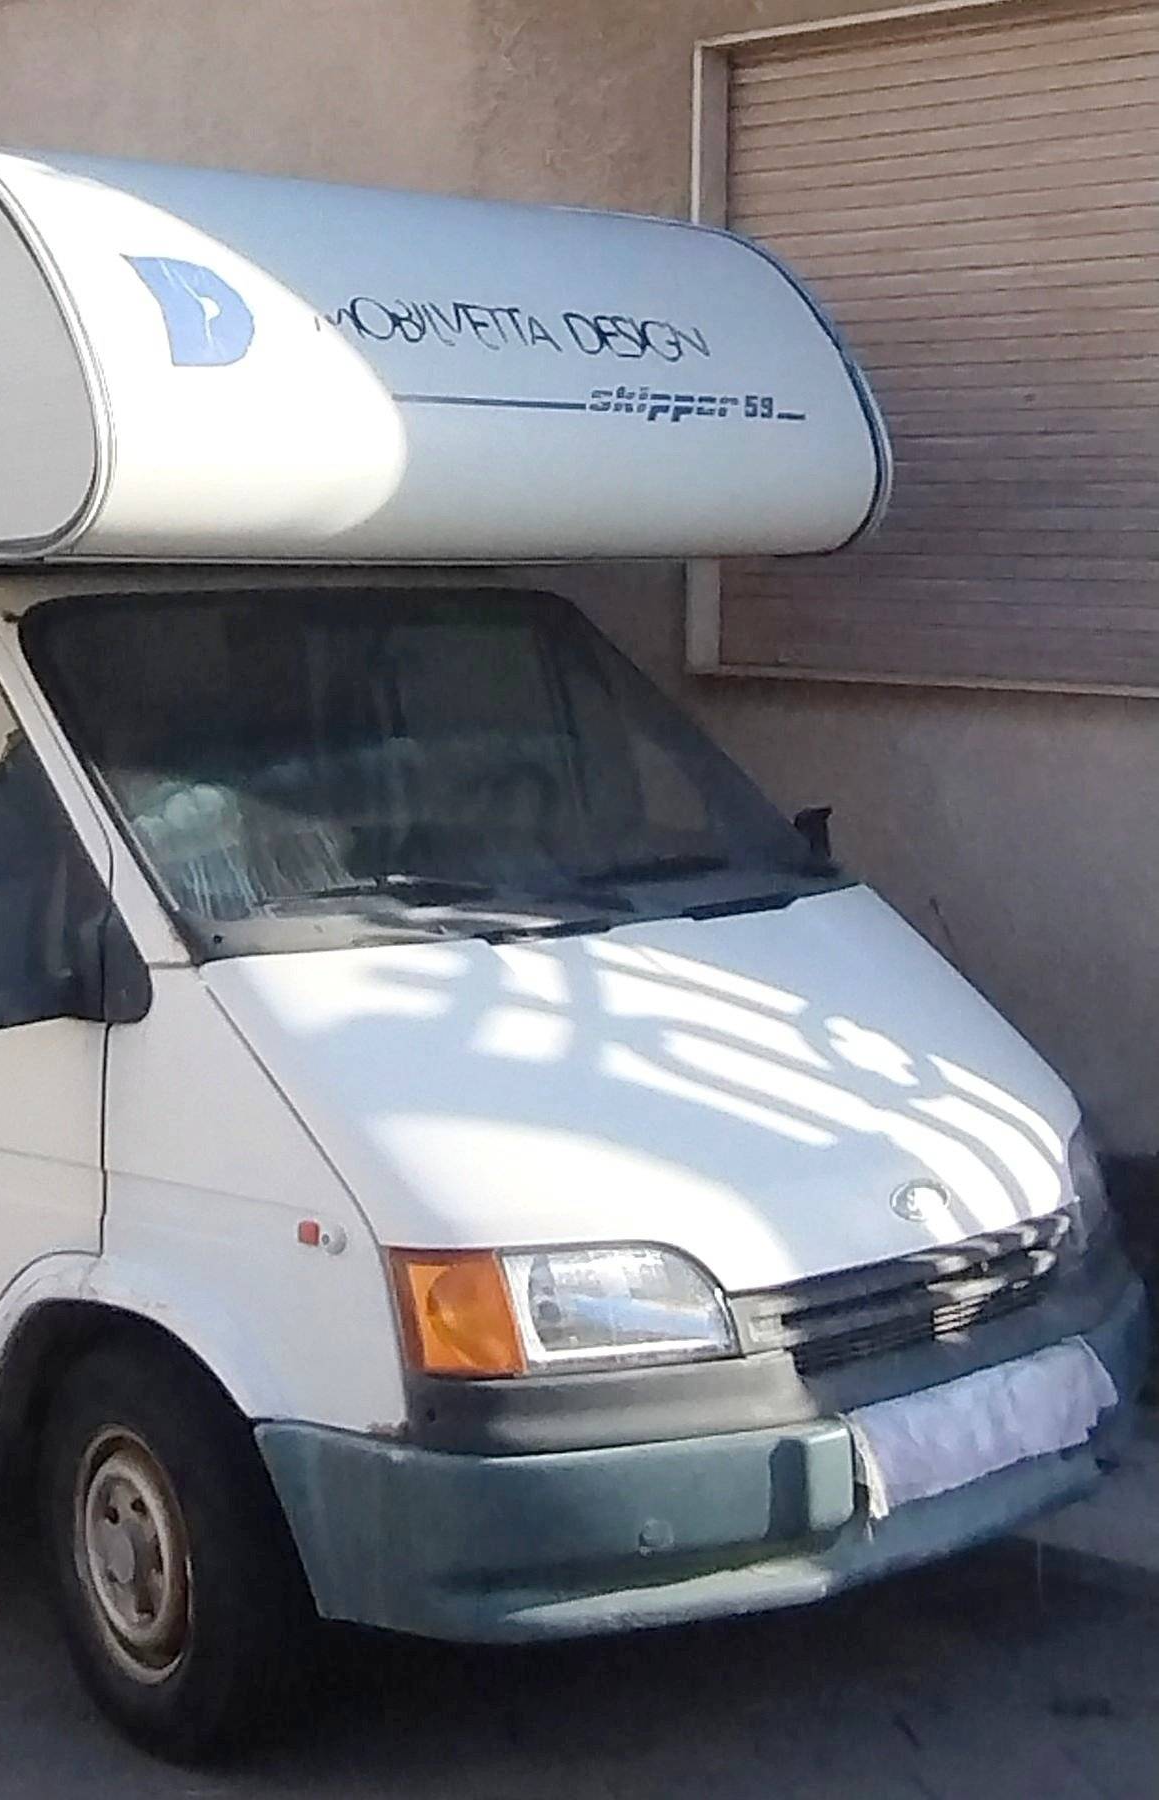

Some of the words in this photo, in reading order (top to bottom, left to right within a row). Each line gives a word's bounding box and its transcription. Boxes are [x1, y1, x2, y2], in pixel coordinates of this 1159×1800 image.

[563, 312, 711, 362] DESIGN
[589, 386, 740, 423] skipper
[744, 394, 774, 419] 59
